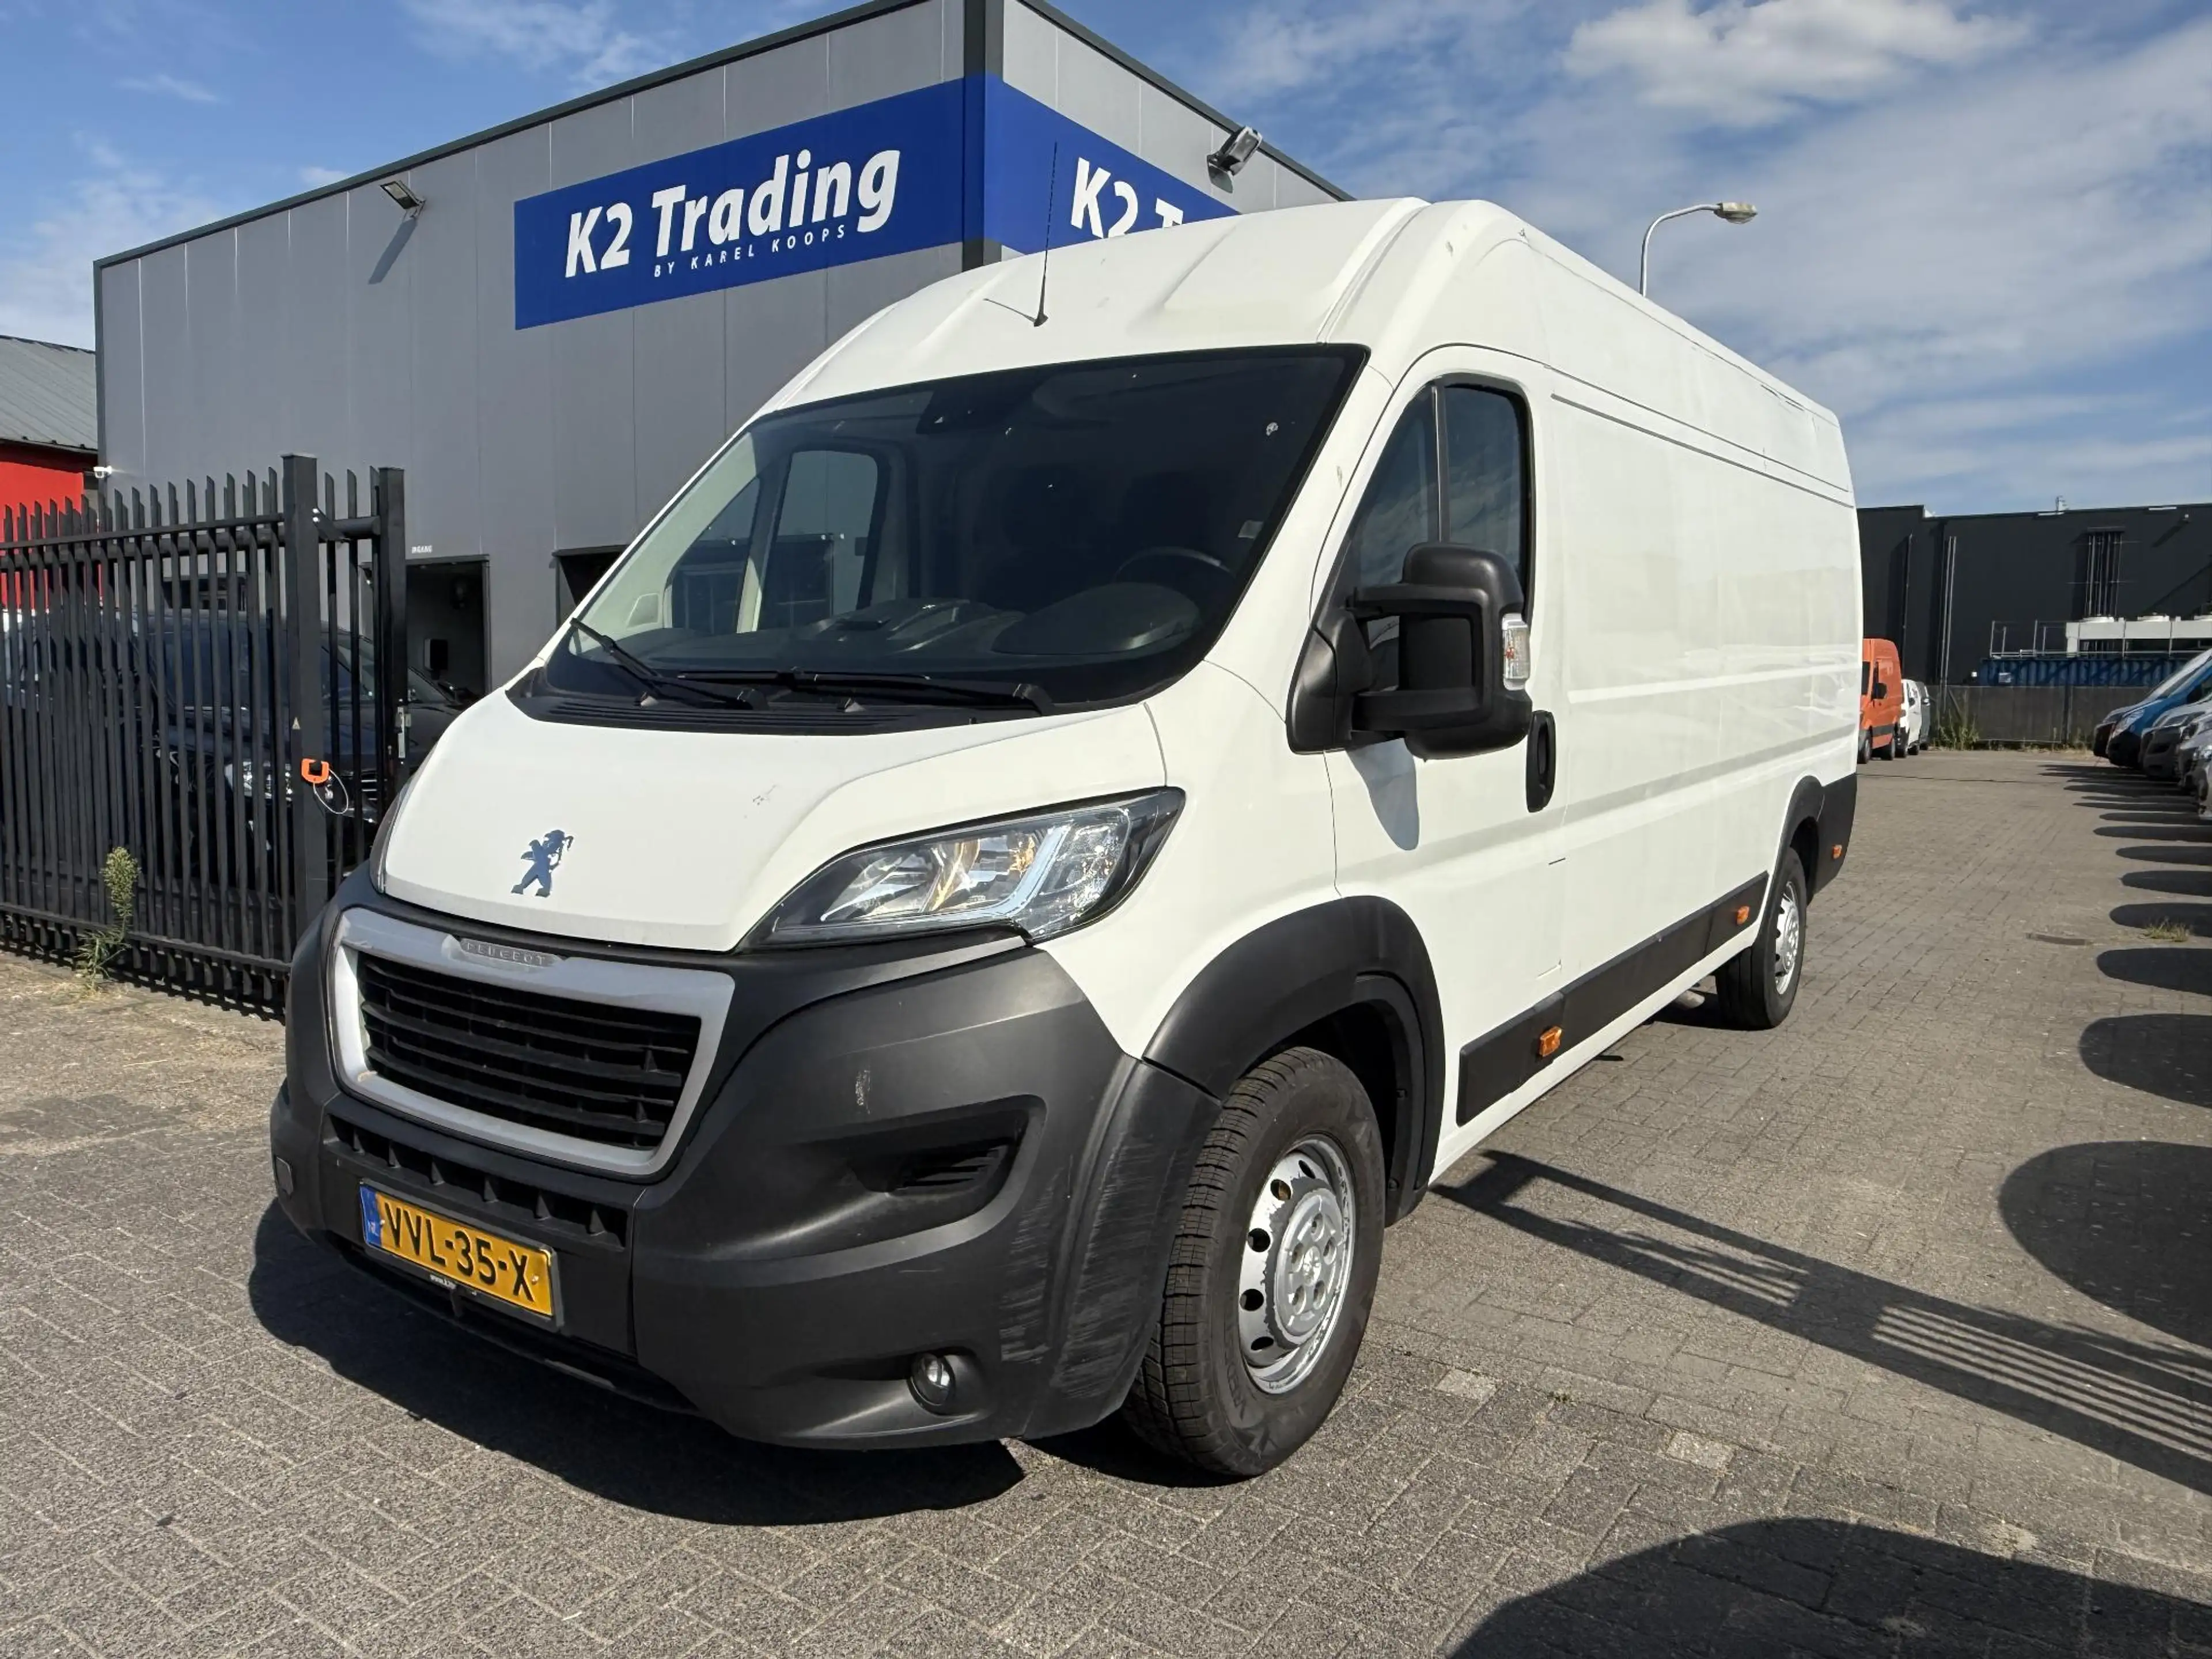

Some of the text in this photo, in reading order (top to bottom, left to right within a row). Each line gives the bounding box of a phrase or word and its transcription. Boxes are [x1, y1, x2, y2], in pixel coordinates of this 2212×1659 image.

[565, 149, 900, 278] K2 Trading
[1071, 157, 1138, 238] K2
[654, 225, 845, 278] BY KAREL KOOPS
[467, 942, 545, 965] PEUGEOT
[385, 1202, 535, 1302] VVL-35-X
